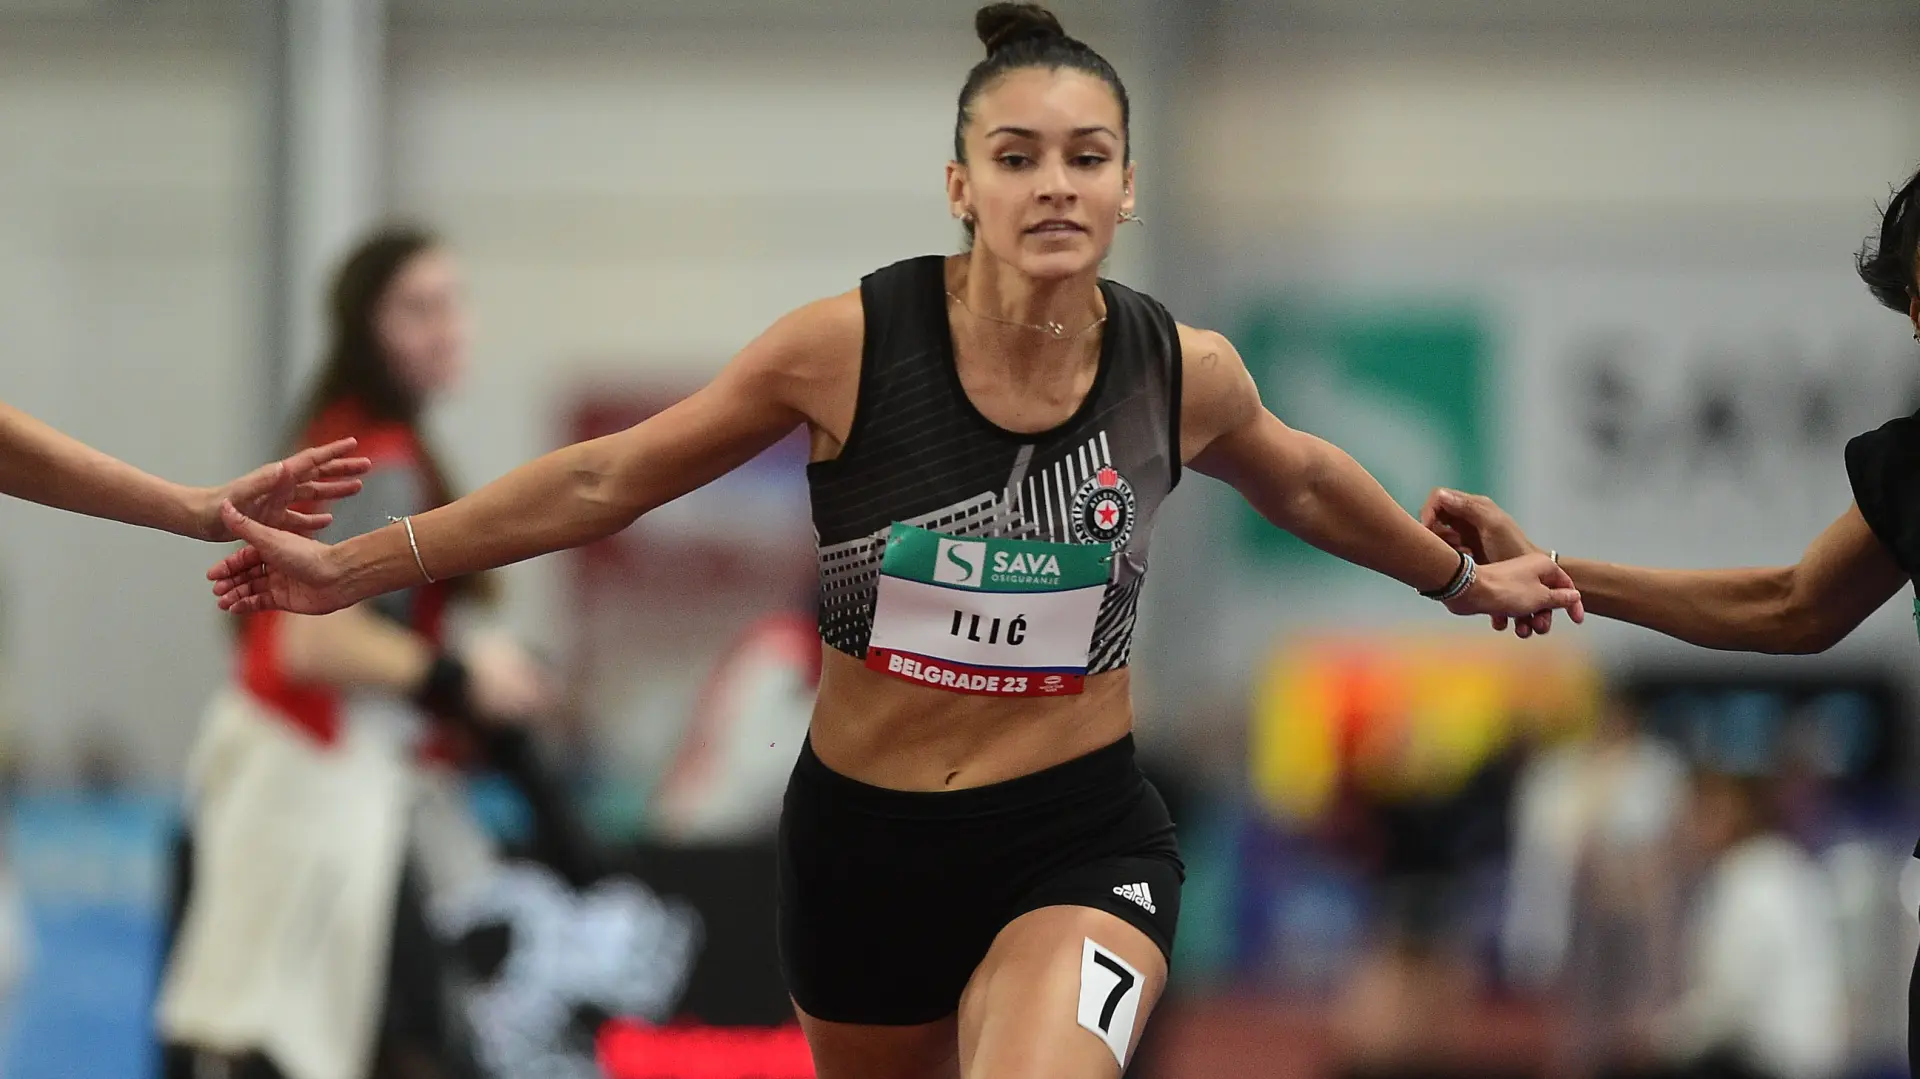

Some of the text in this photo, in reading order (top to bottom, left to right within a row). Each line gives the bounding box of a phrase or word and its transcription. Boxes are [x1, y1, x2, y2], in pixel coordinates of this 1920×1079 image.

[991, 573, 1060, 585] OSIGURANJE
[992, 551, 1061, 576] SAVA
[950, 610, 1027, 646] ILIĆ
[888, 653, 1028, 693] BELGRADE 23
[1112, 886, 1156, 915] adidas
[1093, 950, 1135, 1036] 7
